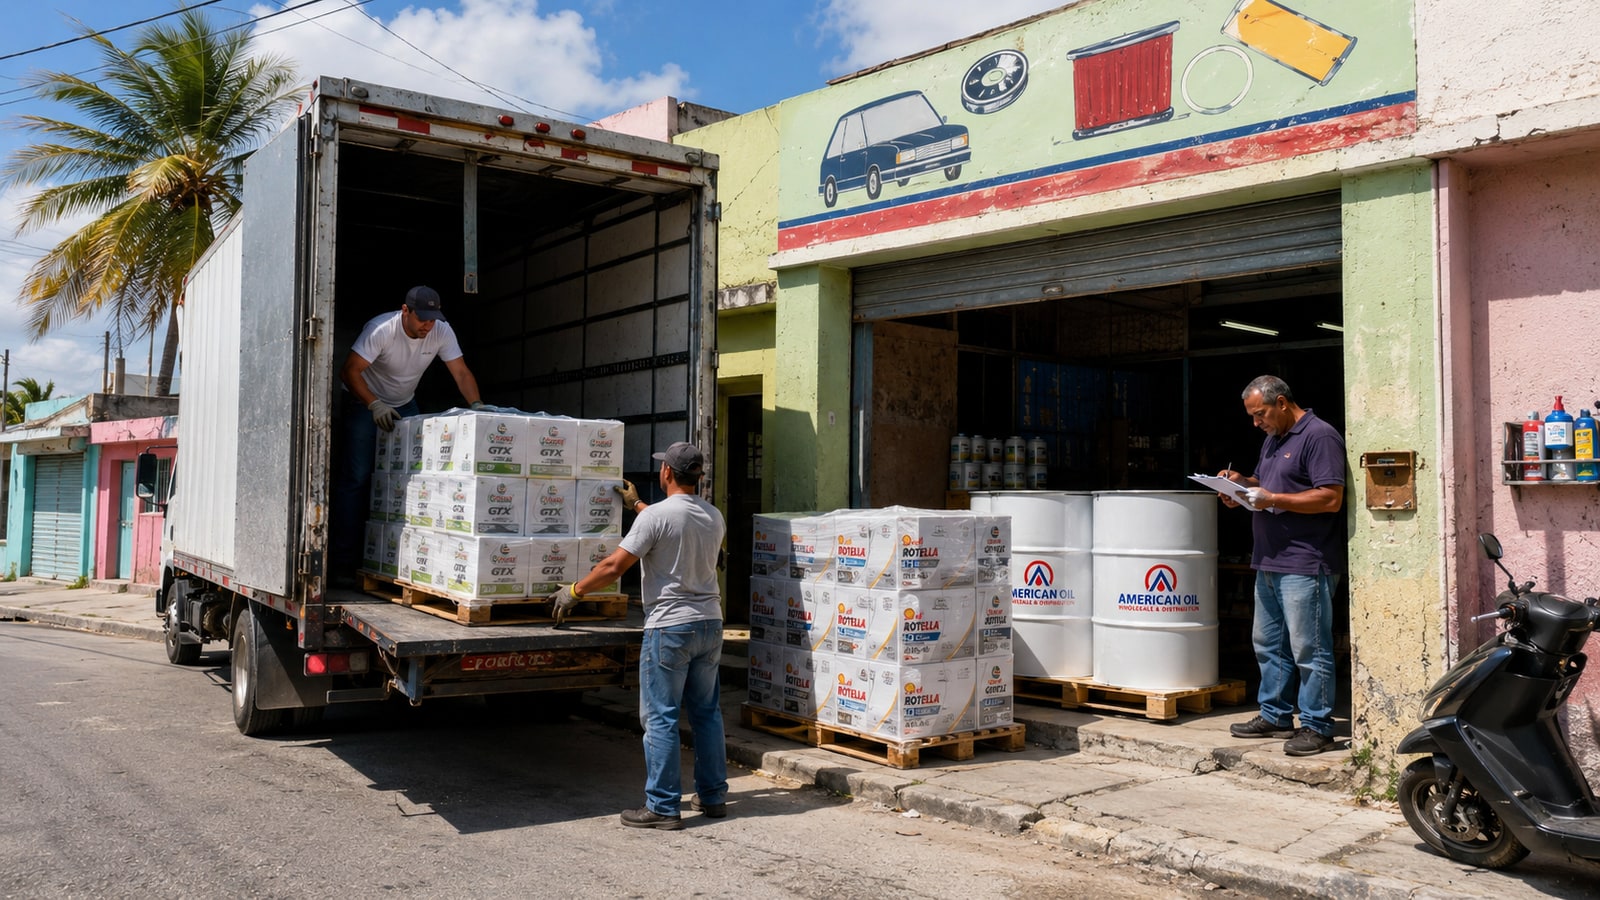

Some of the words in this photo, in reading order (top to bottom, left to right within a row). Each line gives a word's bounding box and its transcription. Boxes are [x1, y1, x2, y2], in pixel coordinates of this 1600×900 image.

[488, 446, 513, 455] GTX
[540, 449, 564, 457] GTX
[589, 450, 612, 459] GTX
[488, 506, 512, 516] GTX
[540, 508, 563, 516] GTX
[589, 508, 611, 517] GTX
[902, 547, 938, 558] ROTELLA
[491, 566, 515, 576] GTX
[541, 566, 565, 575] GTX
[1011, 588, 1057, 599] MERICAN
[1059, 589, 1075, 599] OIL
[1118, 593, 1181, 605] AMERICAN
[1184, 595, 1200, 605] OIL
[903, 620, 940, 632] ROTELLA
[904, 694, 940, 706] ROTELLA
